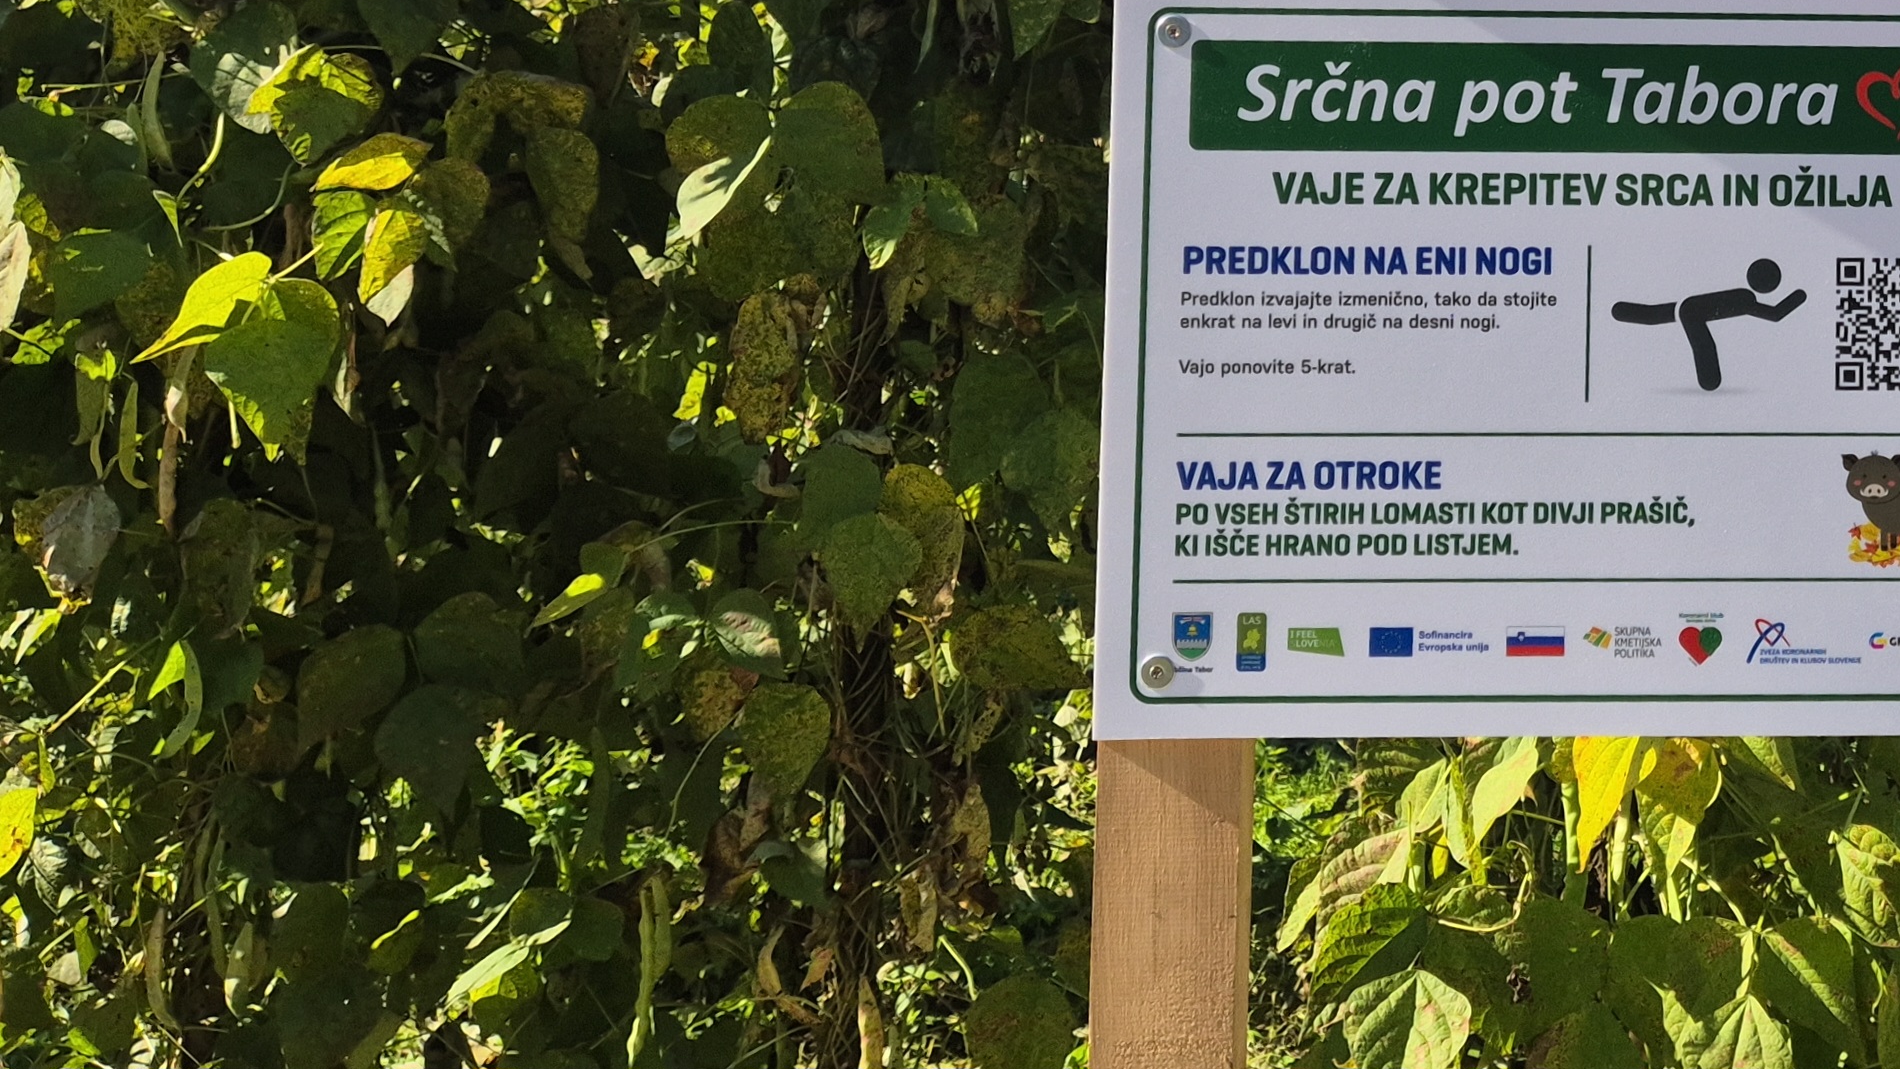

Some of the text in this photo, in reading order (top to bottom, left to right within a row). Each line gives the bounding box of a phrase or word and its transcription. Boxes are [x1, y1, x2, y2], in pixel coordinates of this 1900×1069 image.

[1238, 62, 1839, 136] Srčna pot Tabora
[1273, 165, 1893, 208] VAJE ZA KREPITEV SRCA IN OŽILJA
[1183, 246, 1552, 275] PREDKLON NA ENI NOGI
[1180, 290, 1557, 311] Predklon izvajajte izmenično, tako da stojite
[1180, 313, 1500, 333] enkrat na levi in drugič na desni nogi.
[1179, 359, 1355, 378] Vajo ponovite 5-krat.
[1177, 461, 1442, 490] VAJA ZA OTROKE
[1175, 495, 1695, 528] PO VSEH ŠTIRIH LOMASTI KOT DIVJI PRAŠIČ,
[1175, 528, 1519, 557] KI IŠČE HRANO POD LISTJEM.
[1243, 616, 1261, 625] LAS
[1290, 630, 1317, 638] I FEEL
[1419, 631, 1472, 639] Sofinancira
[1615, 627, 1651, 636] SKUPNA
[1419, 642, 1489, 653] Evropska unija
[1615, 638, 1662, 647] KMETIJSKA
[1615, 649, 1655, 658] POLITIKA
